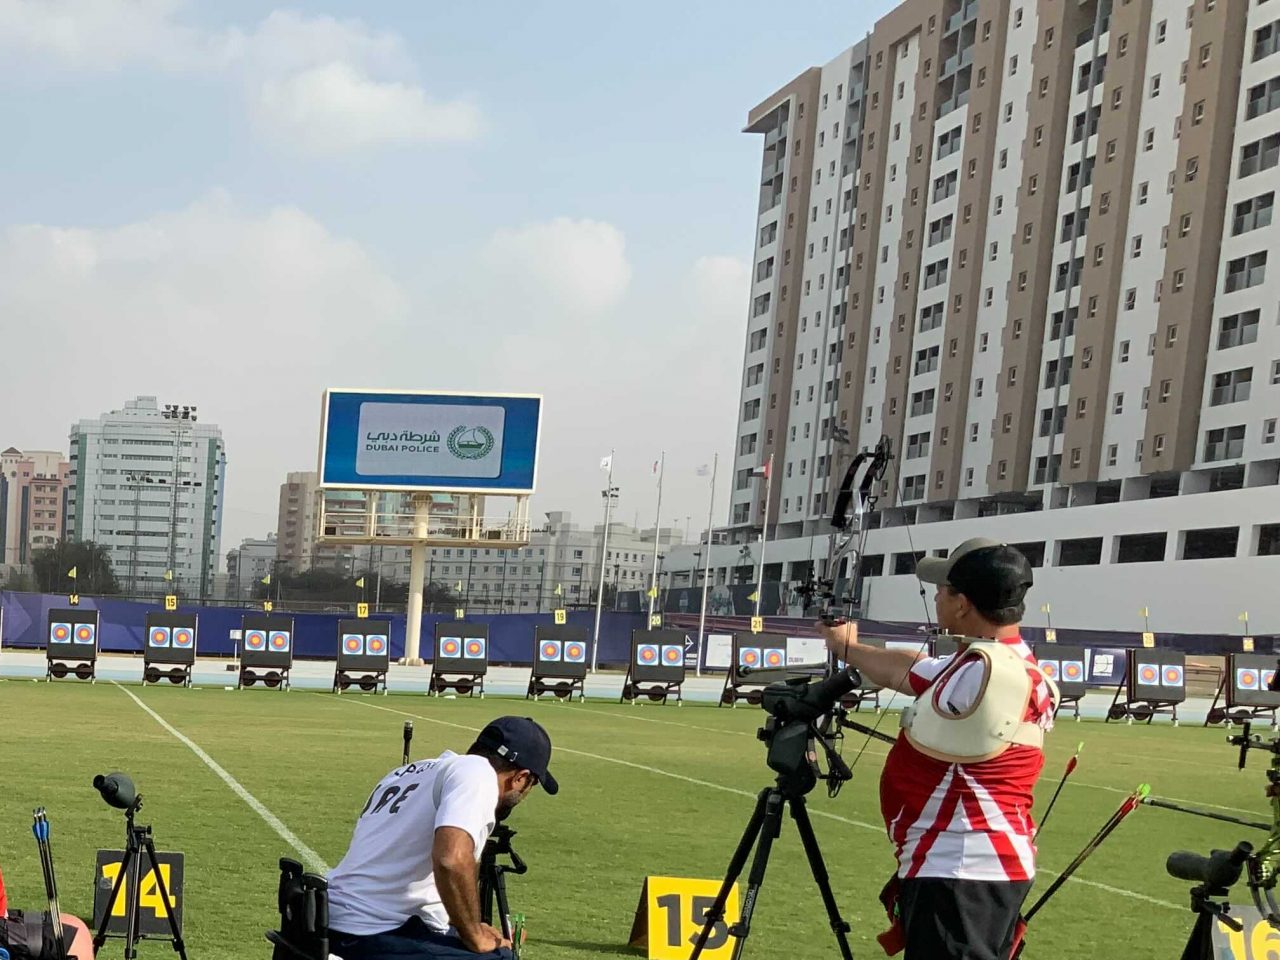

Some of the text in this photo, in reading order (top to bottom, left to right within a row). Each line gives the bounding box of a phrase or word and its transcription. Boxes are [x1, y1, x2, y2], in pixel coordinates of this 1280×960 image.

[366, 430, 441, 444] شرطة دبي
[366, 444, 440, 453] DUBAI POLICE
[70, 595, 79, 604] 14
[167, 598, 176, 607] 15
[263, 602, 272, 611] 16
[359, 606, 368, 615] 17
[455, 609, 464, 618] 18
[556, 612, 564, 621] 19
[651, 615, 661, 625] 20
[753, 620, 761, 629] 21
[101, 861, 176, 918] 14
[655, 893, 729, 950] 15
